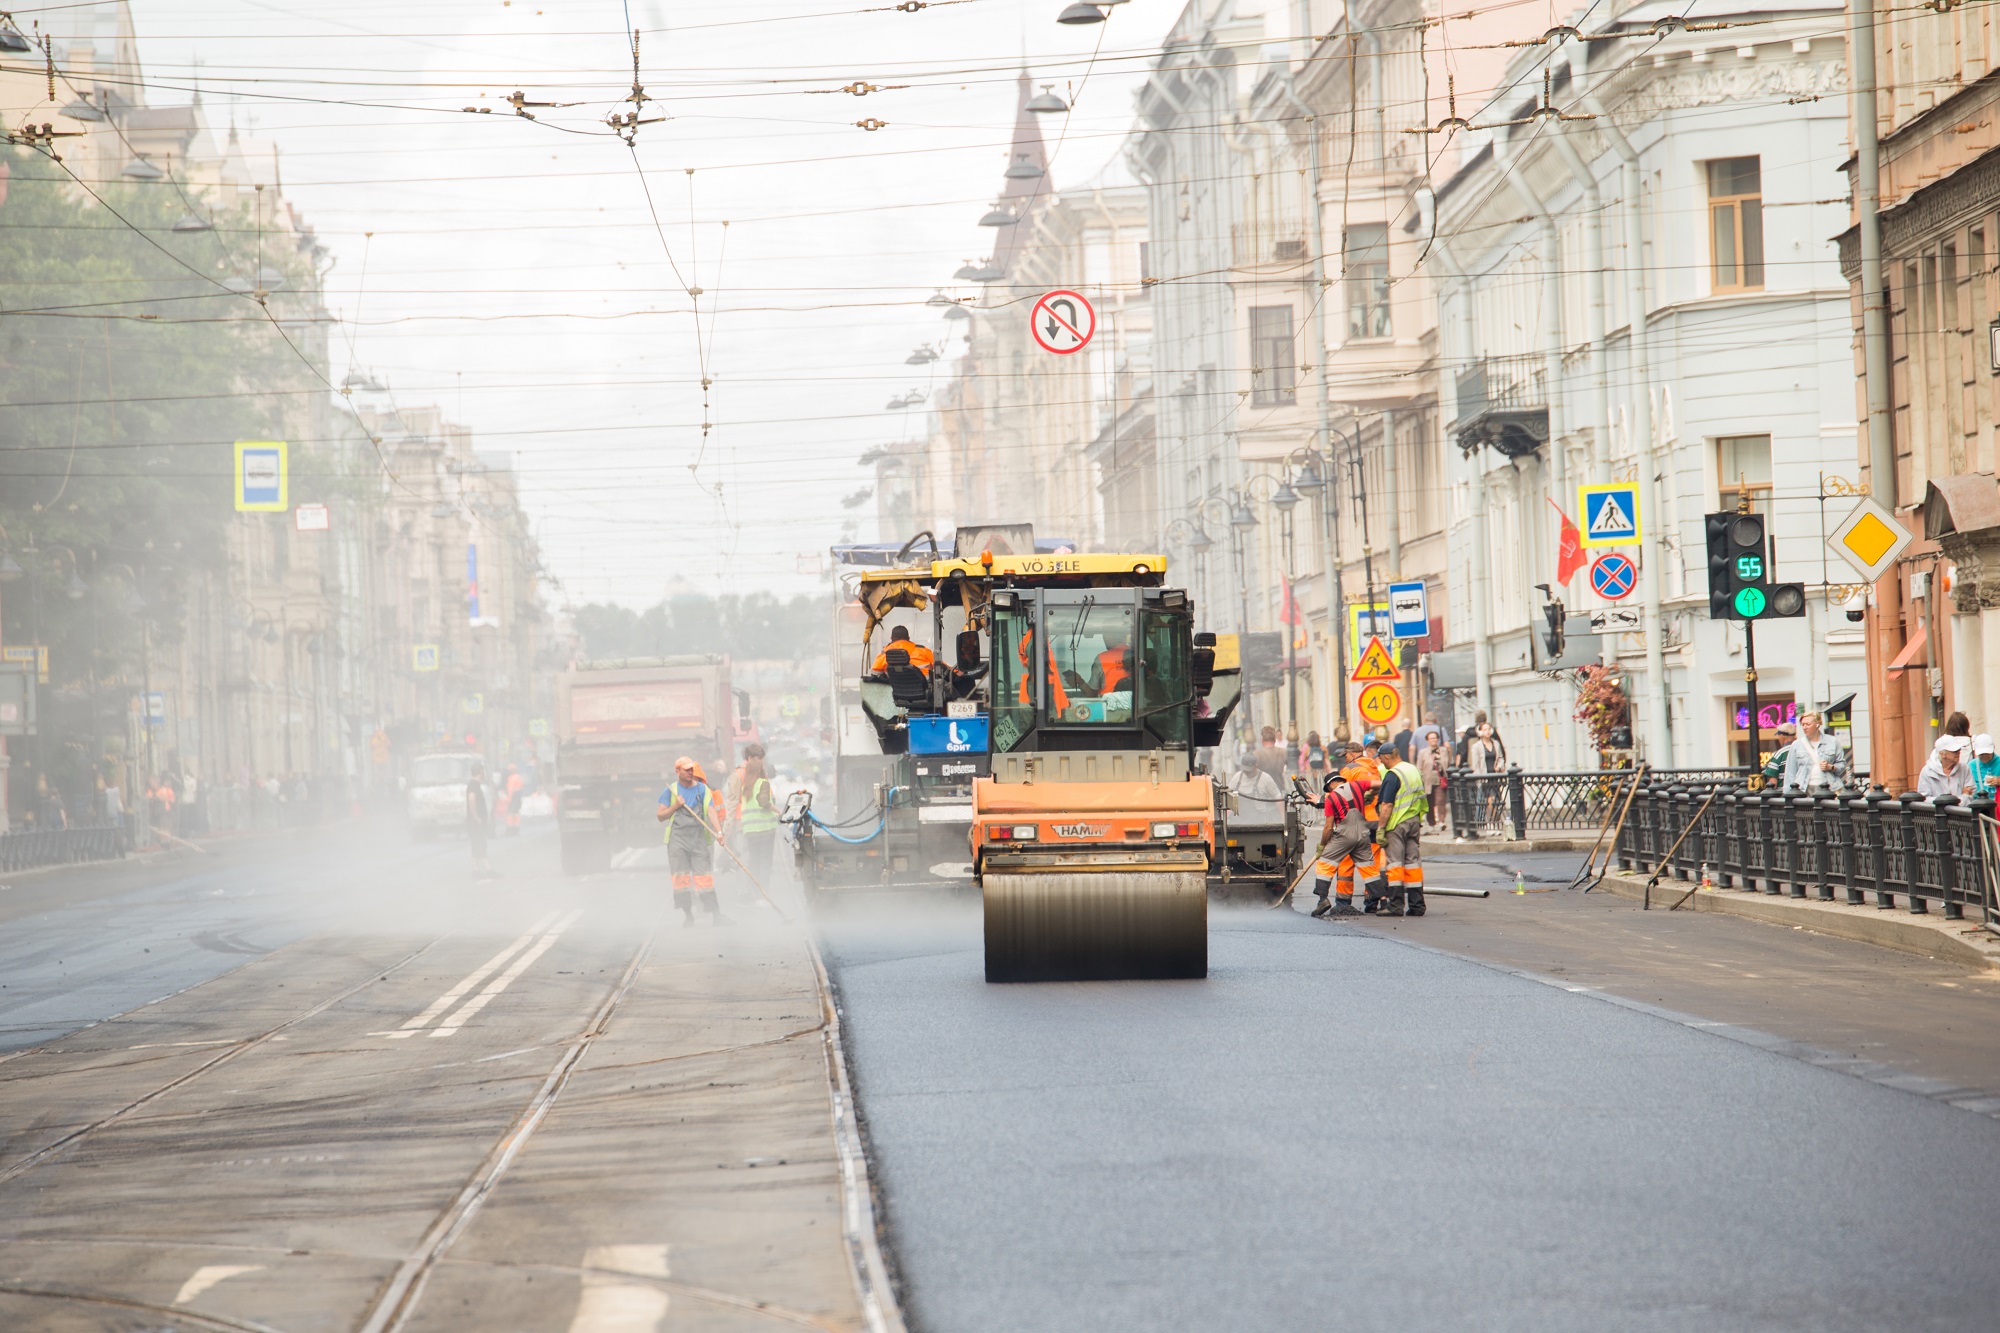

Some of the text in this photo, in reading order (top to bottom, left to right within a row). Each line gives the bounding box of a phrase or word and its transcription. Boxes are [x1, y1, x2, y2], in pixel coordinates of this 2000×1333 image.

[1738, 557, 1761, 577] 55
[951, 704, 973, 713] 9269
[1367, 694, 1392, 711] 40
[946, 743, 971, 752] брит
